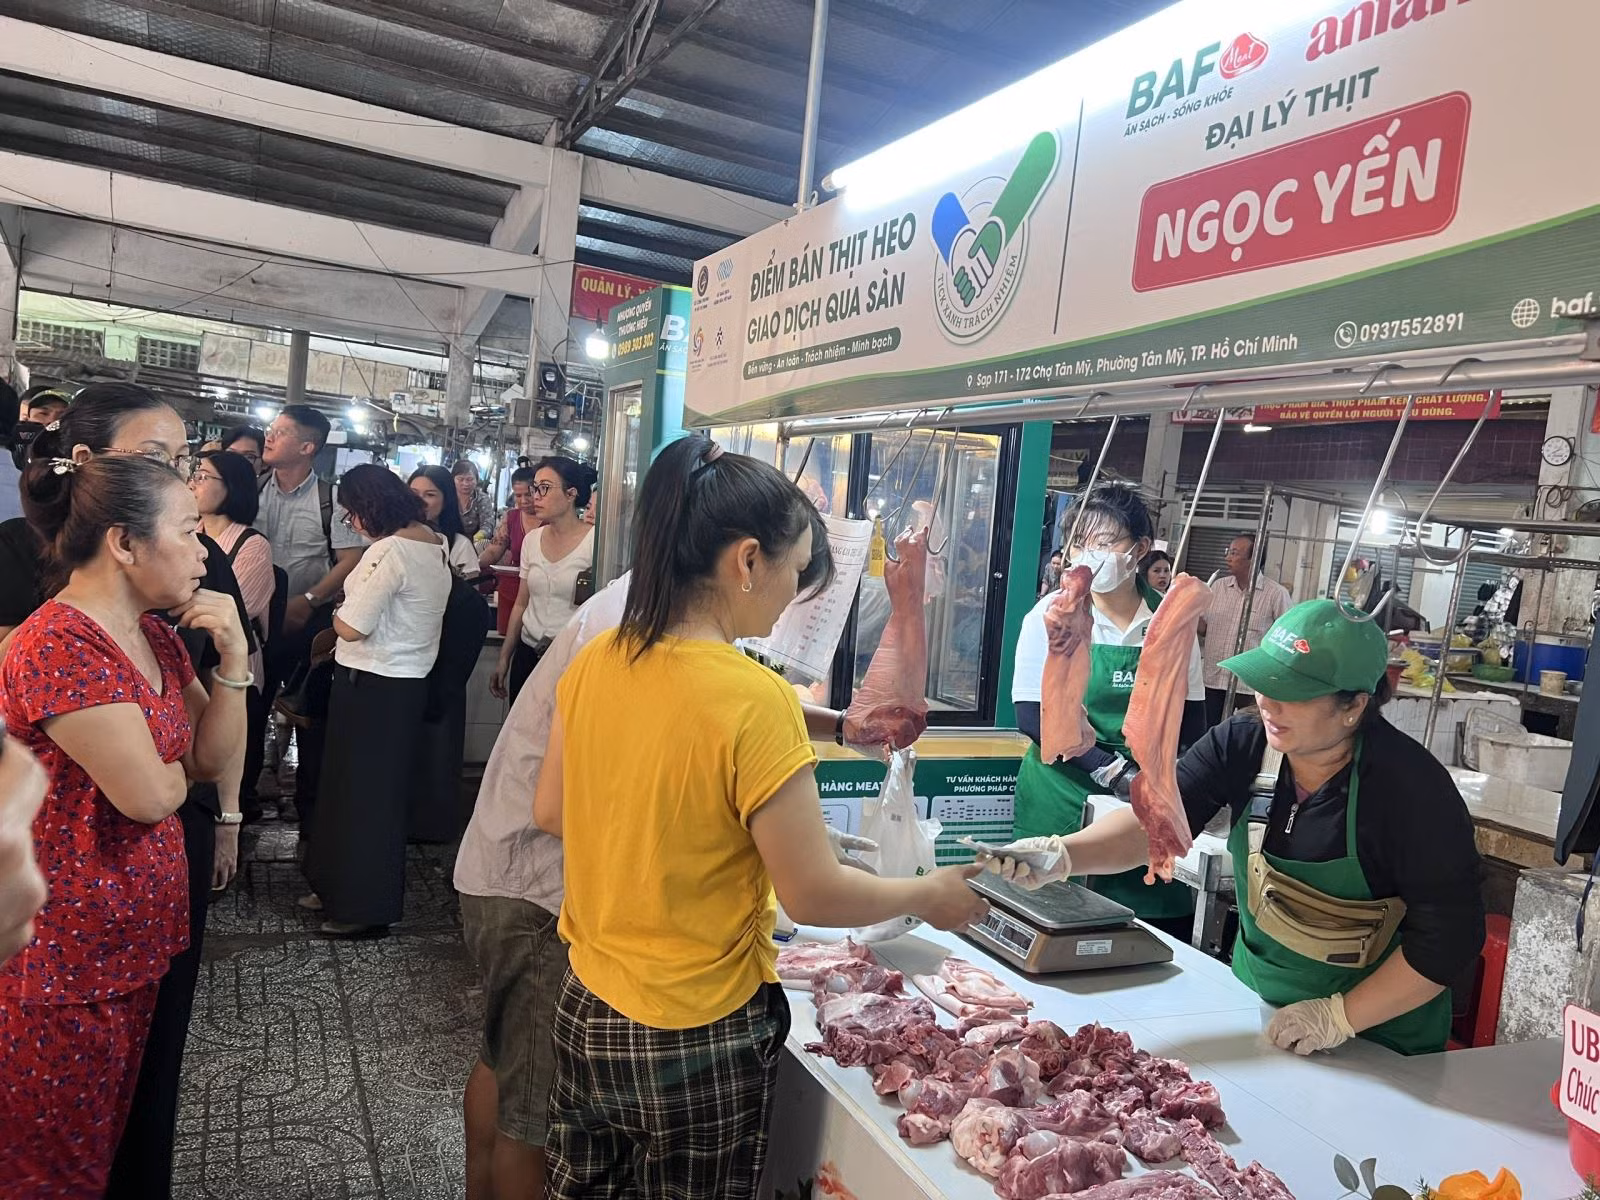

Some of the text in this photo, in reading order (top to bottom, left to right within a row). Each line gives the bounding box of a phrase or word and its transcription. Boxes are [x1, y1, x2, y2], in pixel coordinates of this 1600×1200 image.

[1306, 0, 1472, 61] anla
[1224, 42, 1255, 69] Meat
[1125, 41, 1221, 119] BAF
[1205, 67, 1379, 149] ĐẠI LÝ THỊT
[1152, 118, 1442, 262] NGỌC YẾN
[750, 212, 917, 302] ĐIỂM BÁN THỊT HEO
[581, 275, 615, 296] QUẢN
[747, 268, 906, 344] GIAO DỊCH QUA SÀN
[963, 303, 994, 329] TRÁCH
[1360, 312, 1464, 342] 0937552891
[805, 350, 823, 363] Trách
[851, 340, 870, 353] Minh
[871, 333, 893, 352] bạch
[994, 370, 1008, 384] 171
[1016, 367, 1031, 381] 172
[1032, 365, 1052, 382] Chợ
[1055, 363, 1073, 377] Tân
[1096, 355, 1138, 373] Phường
[1141, 350, 1162, 368] Tân
[1191, 344, 1207, 361] TP.
[1210, 337, 1230, 360] Hồ
[1233, 336, 1260, 357] Chí
[1261, 333, 1298, 353] Minh
[1112, 670, 1137, 682] BA
[820, 779, 853, 792] HÀNG
[1002, 774, 1017, 783] HÀN
[1567, 1067, 1600, 1114] Chúc
